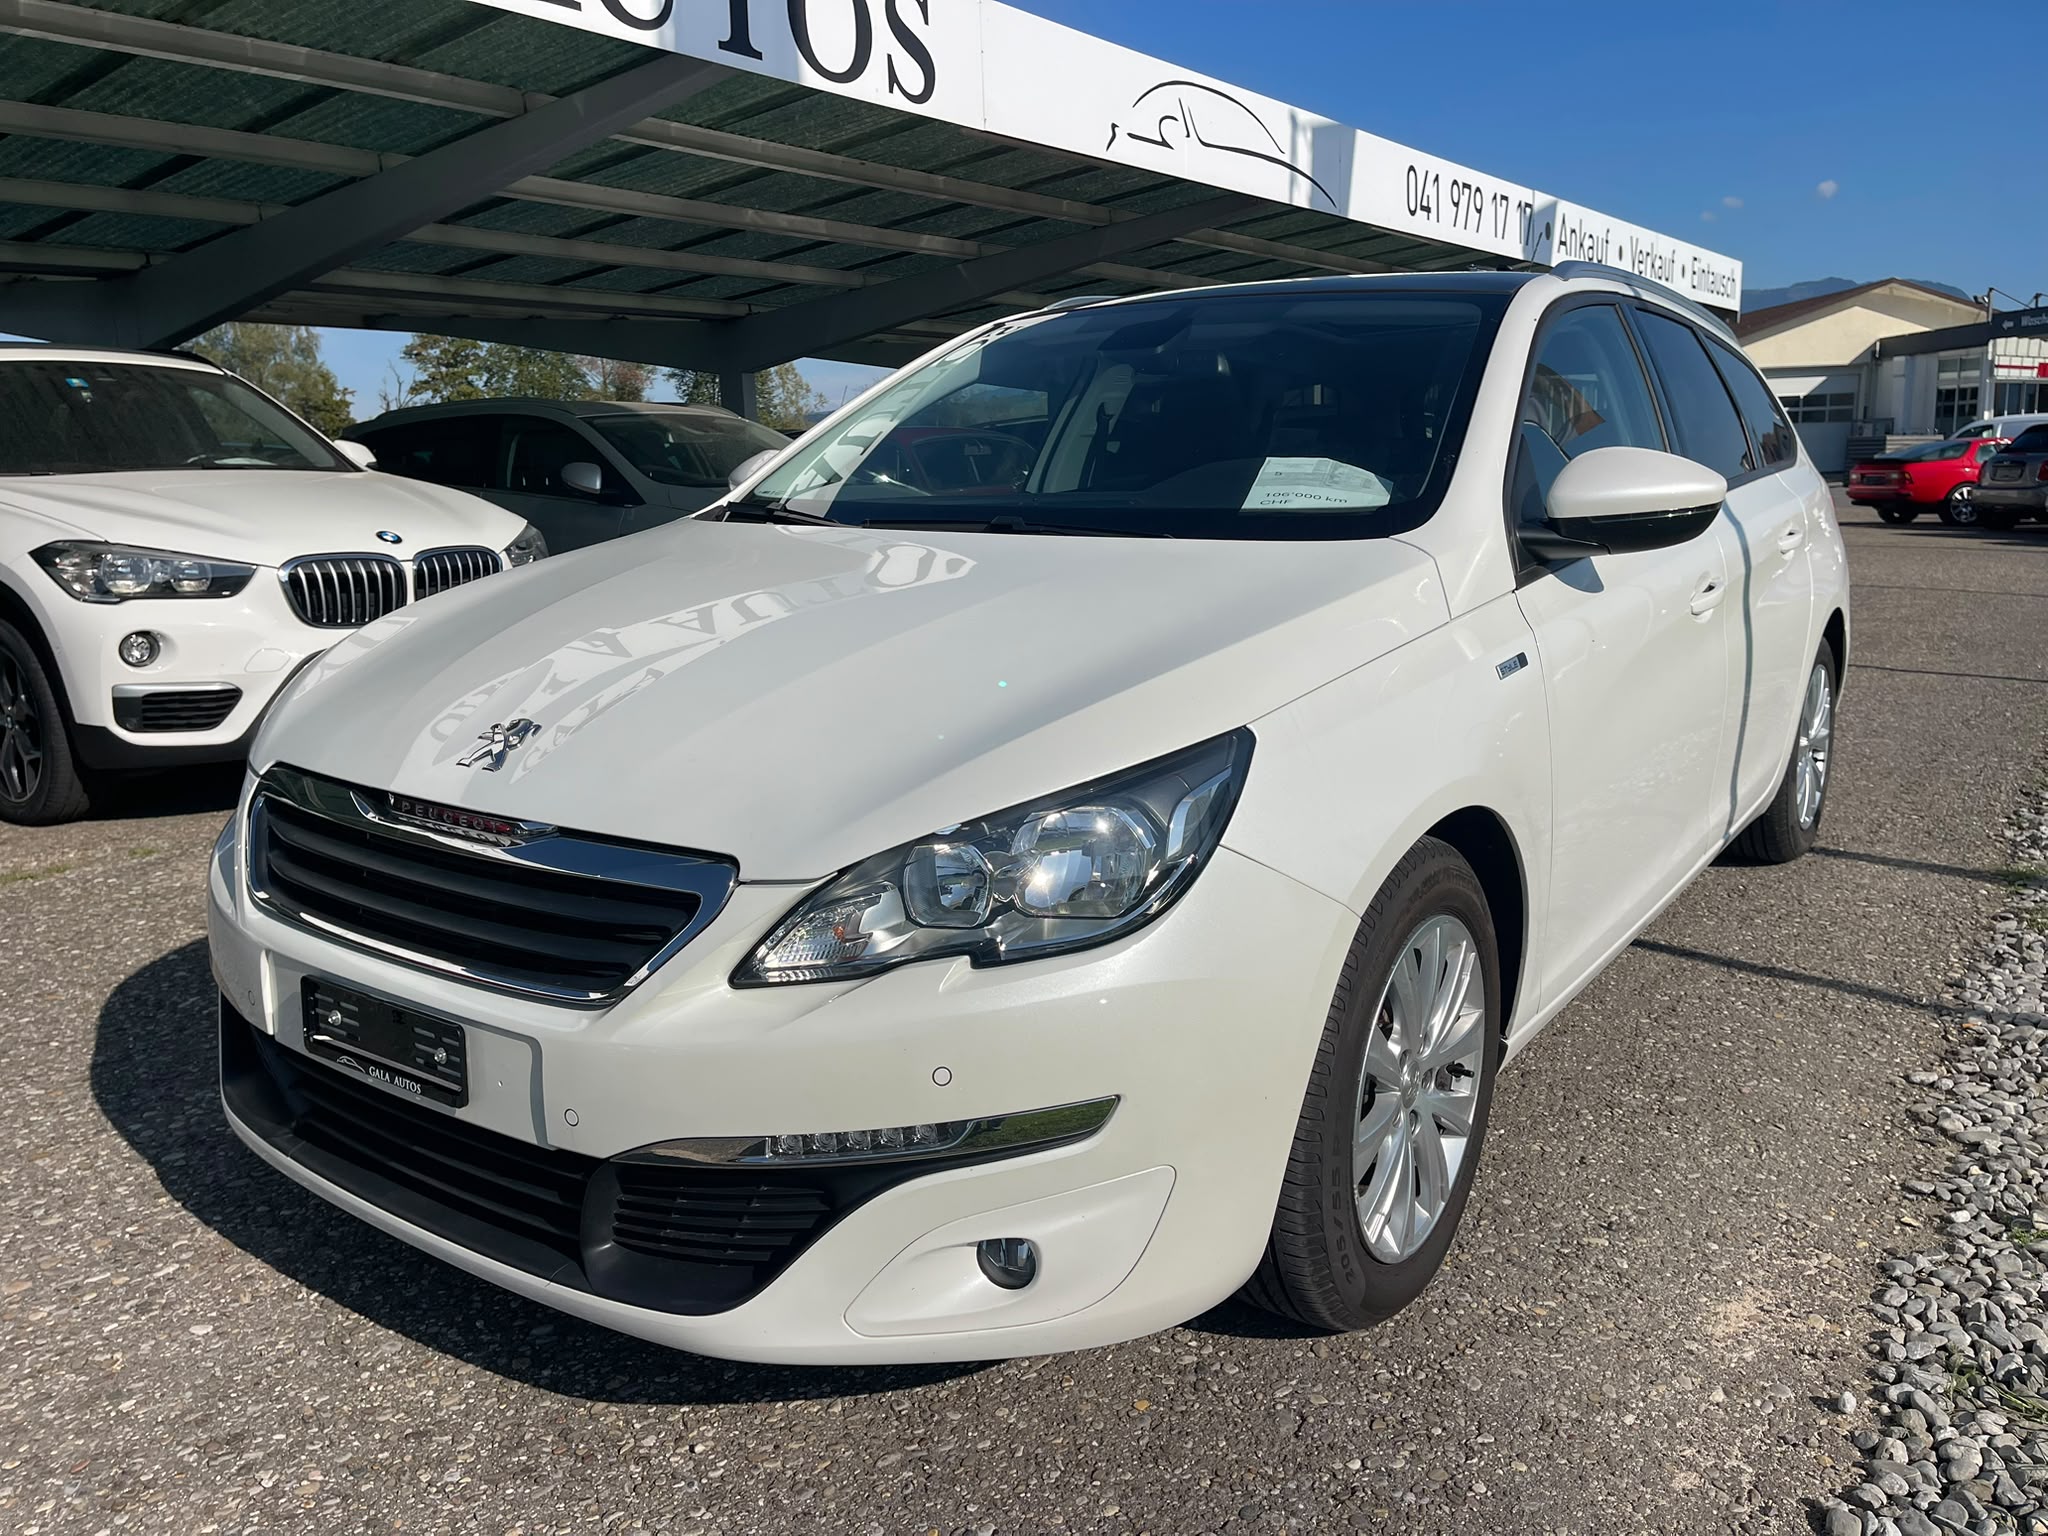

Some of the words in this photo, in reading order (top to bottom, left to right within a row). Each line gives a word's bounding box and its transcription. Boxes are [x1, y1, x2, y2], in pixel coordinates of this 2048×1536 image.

[1407, 165, 1440, 223] 041
[1451, 179, 1484, 233] 979
[1492, 192, 1509, 240] 17
[1516, 200, 1534, 246] 17
[1557, 212, 1610, 264] Ankauf
[1630, 236, 1676, 284] Verkauf
[1690, 256, 1737, 300] Eintausch
[1266, 491, 1322, 500] 106'000
[401, 802, 502, 833] PEUGEOT
[368, 1065, 390, 1083] GALA
[393, 1074, 422, 1095] AUTOS
